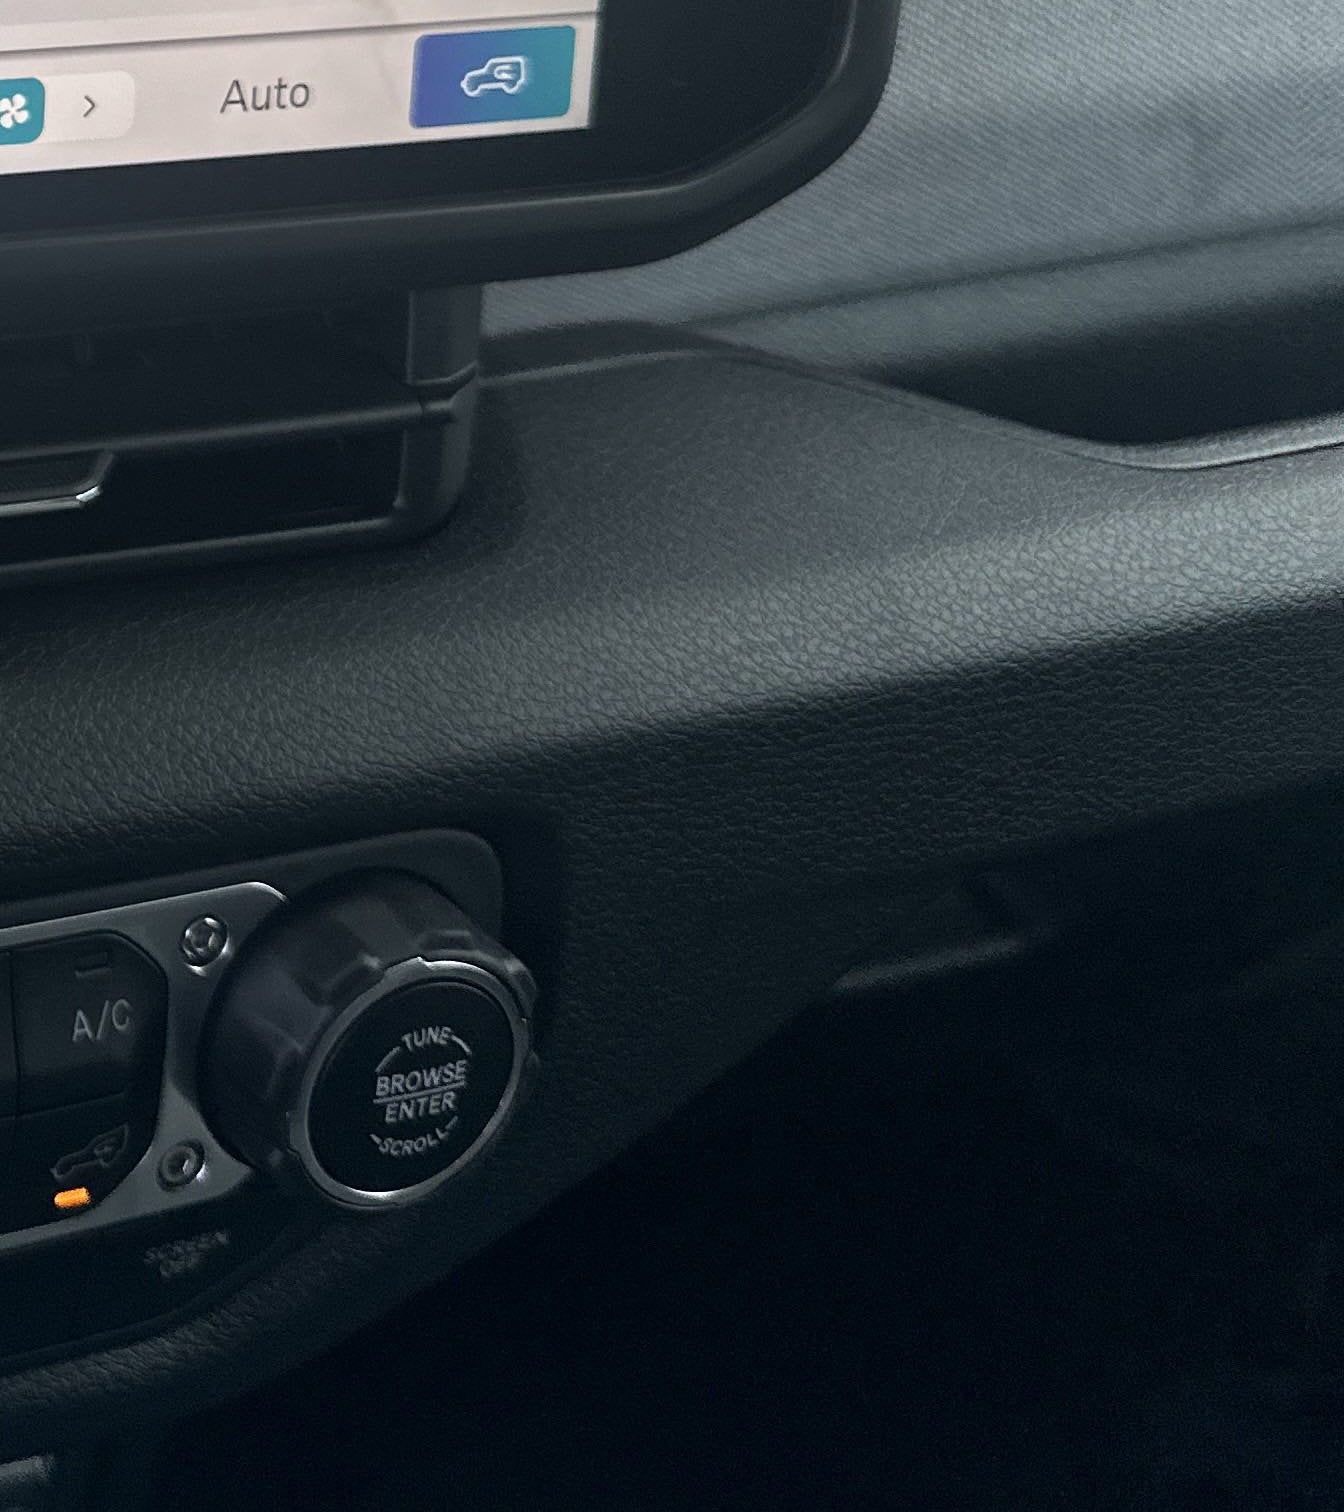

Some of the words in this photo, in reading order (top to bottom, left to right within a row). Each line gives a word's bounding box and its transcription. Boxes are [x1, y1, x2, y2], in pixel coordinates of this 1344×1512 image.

[219, 76, 311, 115] Auto
[71, 998, 133, 1044] A/C
[401, 1025, 453, 1049] TUNE
[375, 1059, 467, 1097] BROWSE
[385, 1091, 455, 1124] ENTER
[377, 1127, 448, 1157] SCROLL
